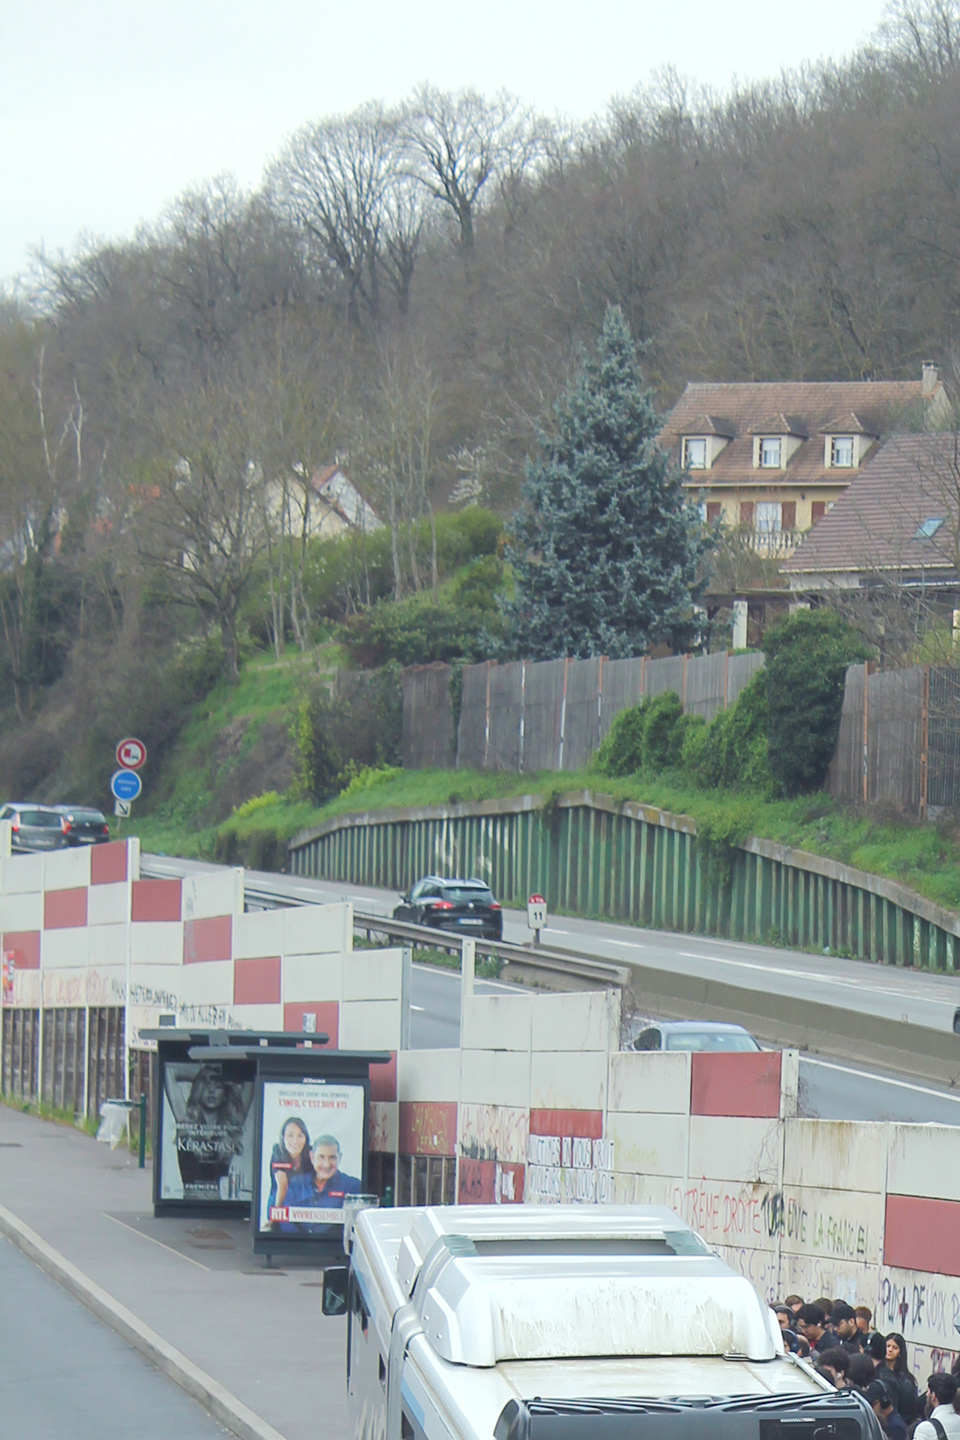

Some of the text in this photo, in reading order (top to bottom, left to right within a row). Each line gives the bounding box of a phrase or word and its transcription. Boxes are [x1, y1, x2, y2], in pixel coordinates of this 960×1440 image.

[533, 911, 543, 921] 11
[321, 1100, 335, 1109] SUR
[336, 1101, 348, 1110] RTL
[270, 1207, 288, 1221] RTL
[723, 1195, 761, 1234] DROITE
